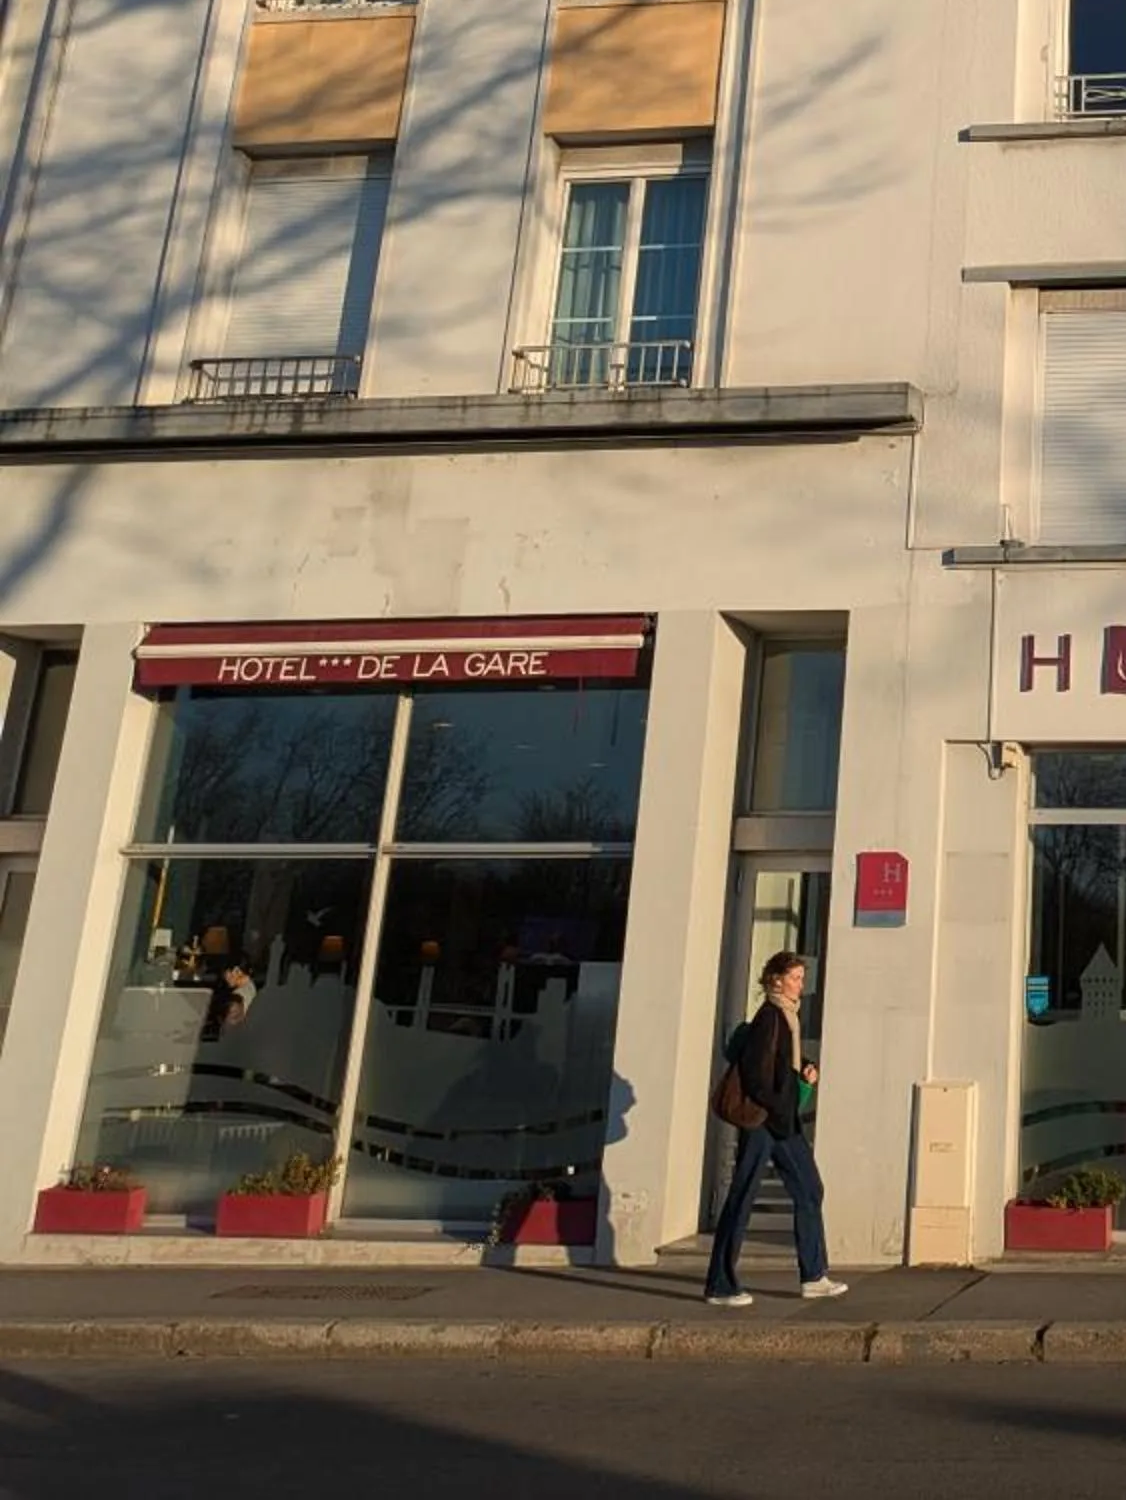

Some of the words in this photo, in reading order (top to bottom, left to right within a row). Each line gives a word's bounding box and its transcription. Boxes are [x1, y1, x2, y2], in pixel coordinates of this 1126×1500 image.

[217, 657, 317, 681] HOTEL
[357, 655, 401, 679] DE
[412, 654, 450, 677] LA
[463, 651, 549, 677] GARE
[882, 860, 902, 883] H
